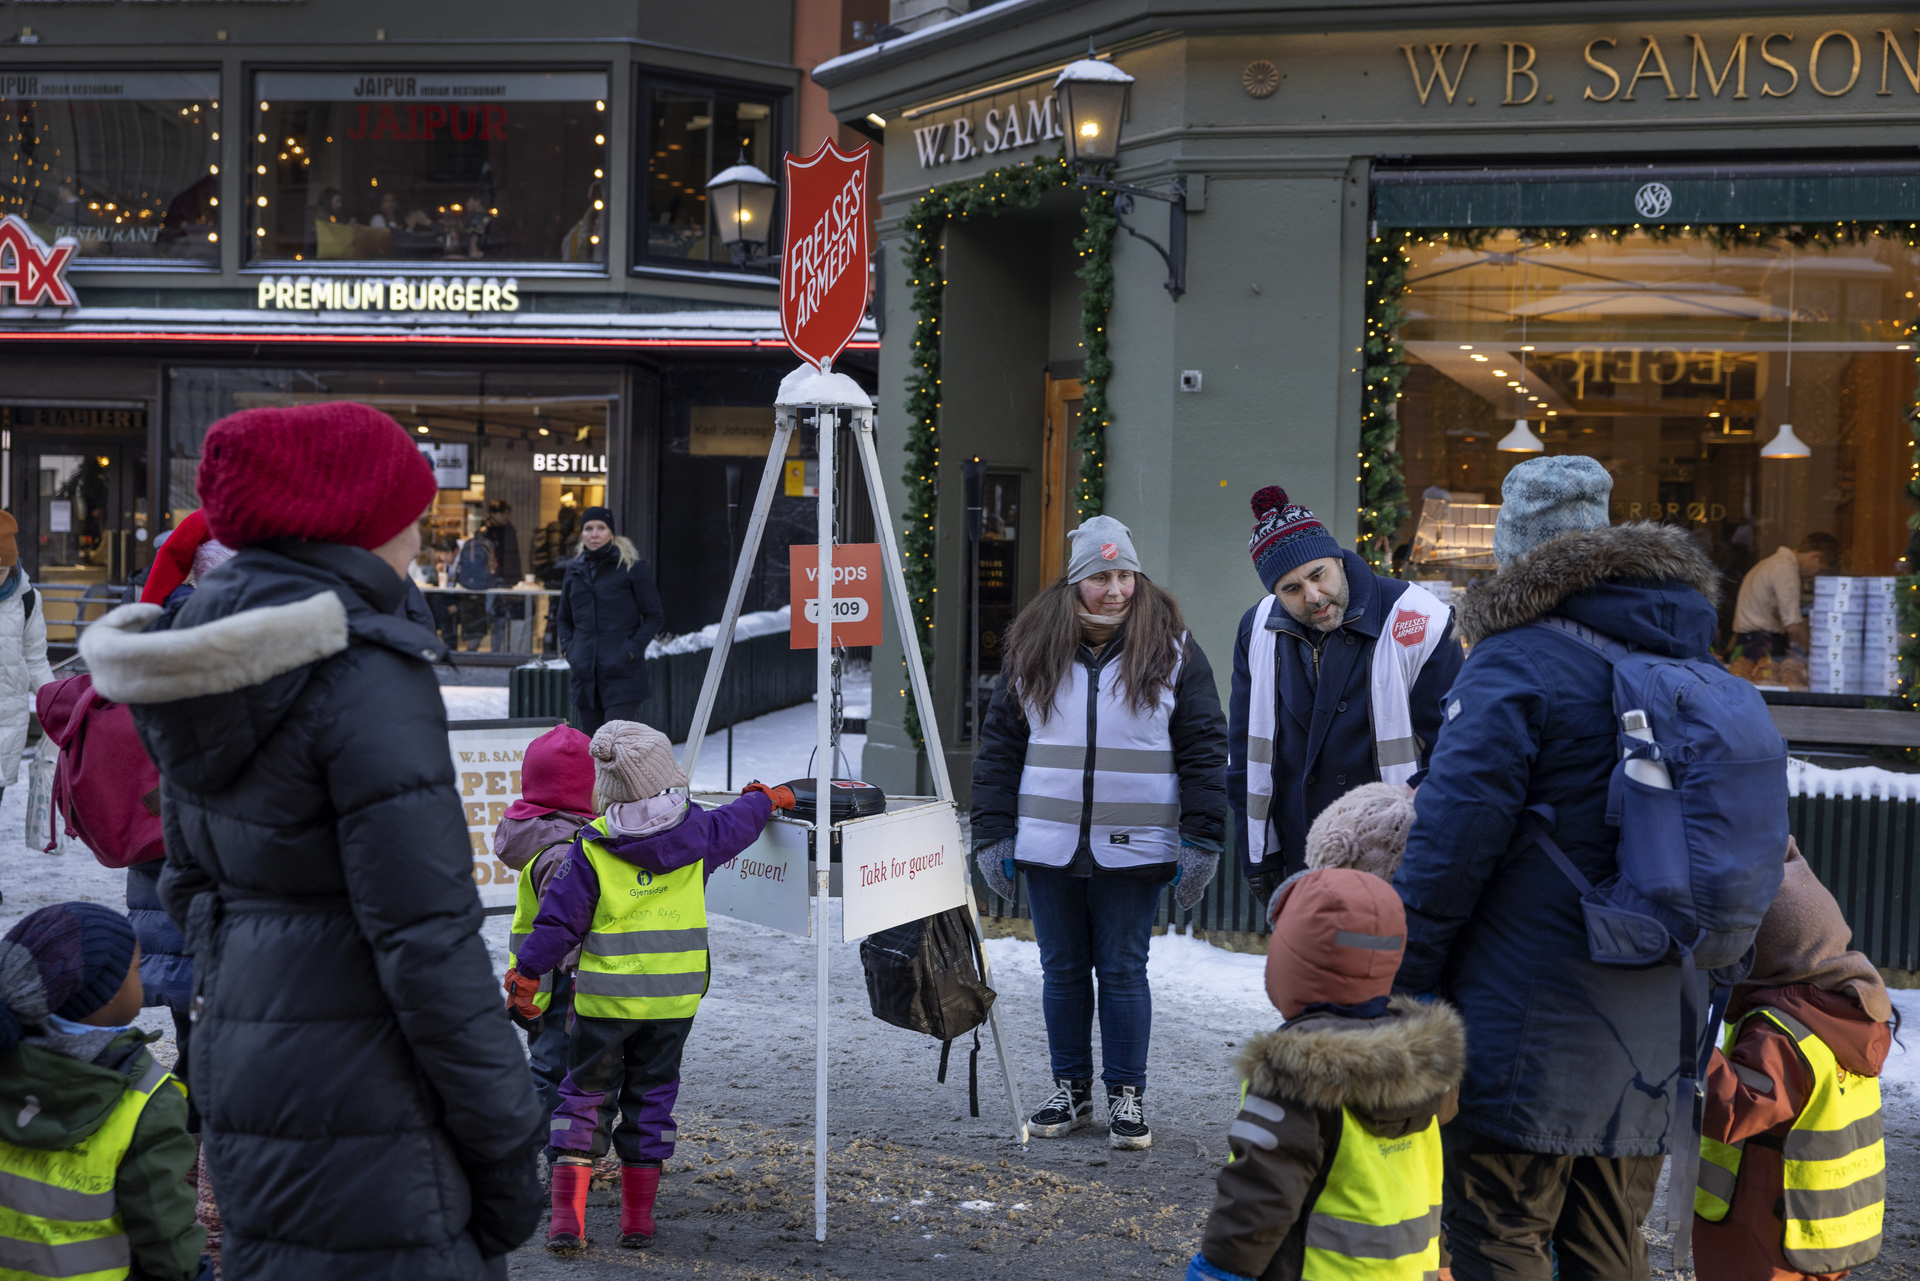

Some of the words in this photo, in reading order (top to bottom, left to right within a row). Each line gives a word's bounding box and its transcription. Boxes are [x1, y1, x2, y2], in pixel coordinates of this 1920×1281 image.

[1400, 42, 1478, 106] W.
[1501, 41, 1554, 106] B.
[1583, 28, 1920, 102] SAMSON
[354, 77, 417, 97] JAIPUR
[452, 85, 506, 97] RESTAURANT
[347, 104, 508, 141] JAIPUR
[913, 123, 946, 169] W.
[952, 117, 977, 162] B.
[54, 226, 162, 243] RESTAURANT
[794, 217, 858, 340] ARMEEN
[258, 282, 384, 310] PREMIUM
[389, 282, 519, 311] BURGERS
[805, 566, 867, 586] vpps
[813, 602, 860, 617] 7109
[1395, 625, 1425, 639] ARMEEN
[458, 751, 475, 763] W.
[478, 751, 490, 763] B.
[469, 831, 497, 856] A
[471, 860, 522, 886] DE
[740, 859, 787, 882] gaven!
[860, 861, 887, 887] Takk
[891, 857, 907, 879] for
[909, 845, 944, 880] gaven!
[630, 884, 669, 898] Gjensidige
